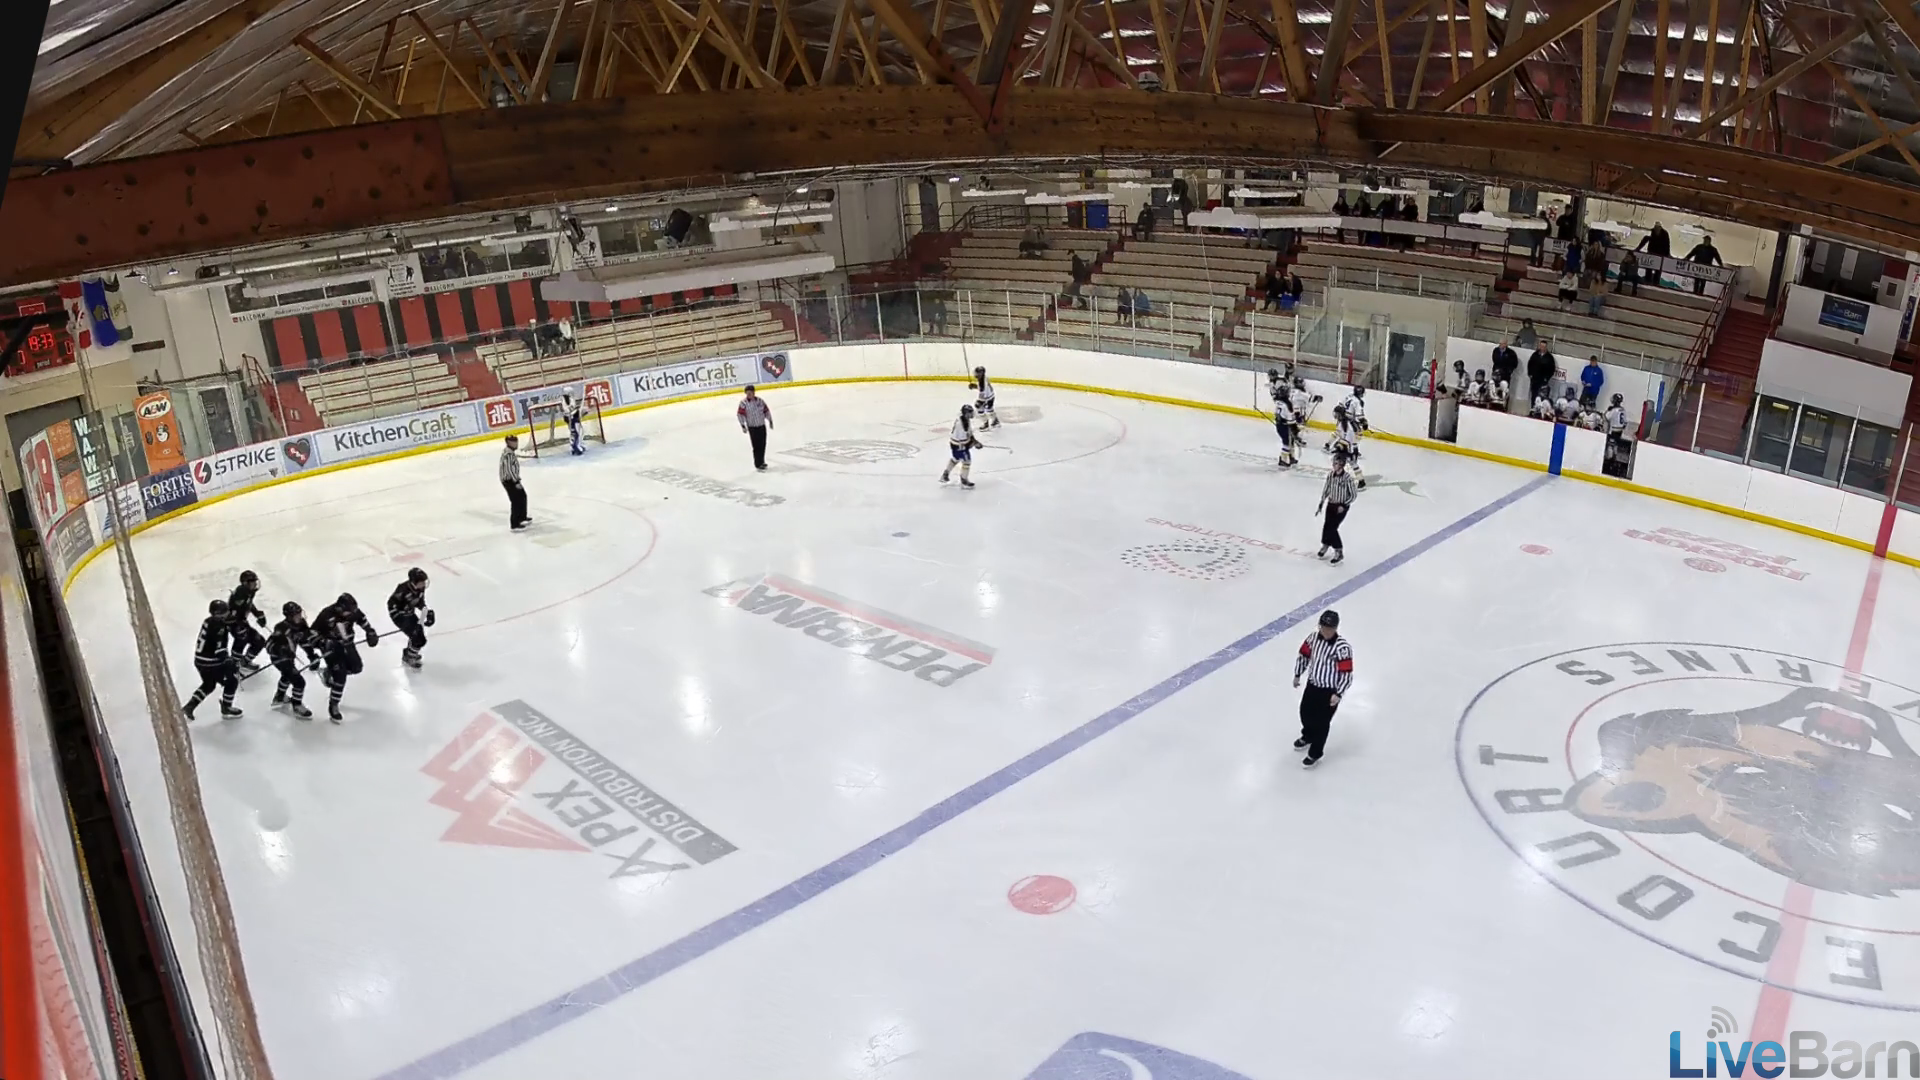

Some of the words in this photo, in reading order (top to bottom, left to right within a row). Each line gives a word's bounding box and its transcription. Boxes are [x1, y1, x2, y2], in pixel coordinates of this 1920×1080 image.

[28, 333, 54, 352] 19:33
[634, 362, 736, 394] KitchenCraft
[142, 401, 169, 416] A&W
[334, 412, 456, 451] KitchenCraft
[413, 430, 458, 443] CABINETRY
[215, 446, 276, 476] STRIKE
[142, 472, 194, 501] FORTIS
[146, 483, 195, 510] ALBERTA
[1144, 517, 1285, 552] SOLUTIONS
[548, 729, 705, 844] DISTRIBUTION
[532, 778, 692, 880] APEX
